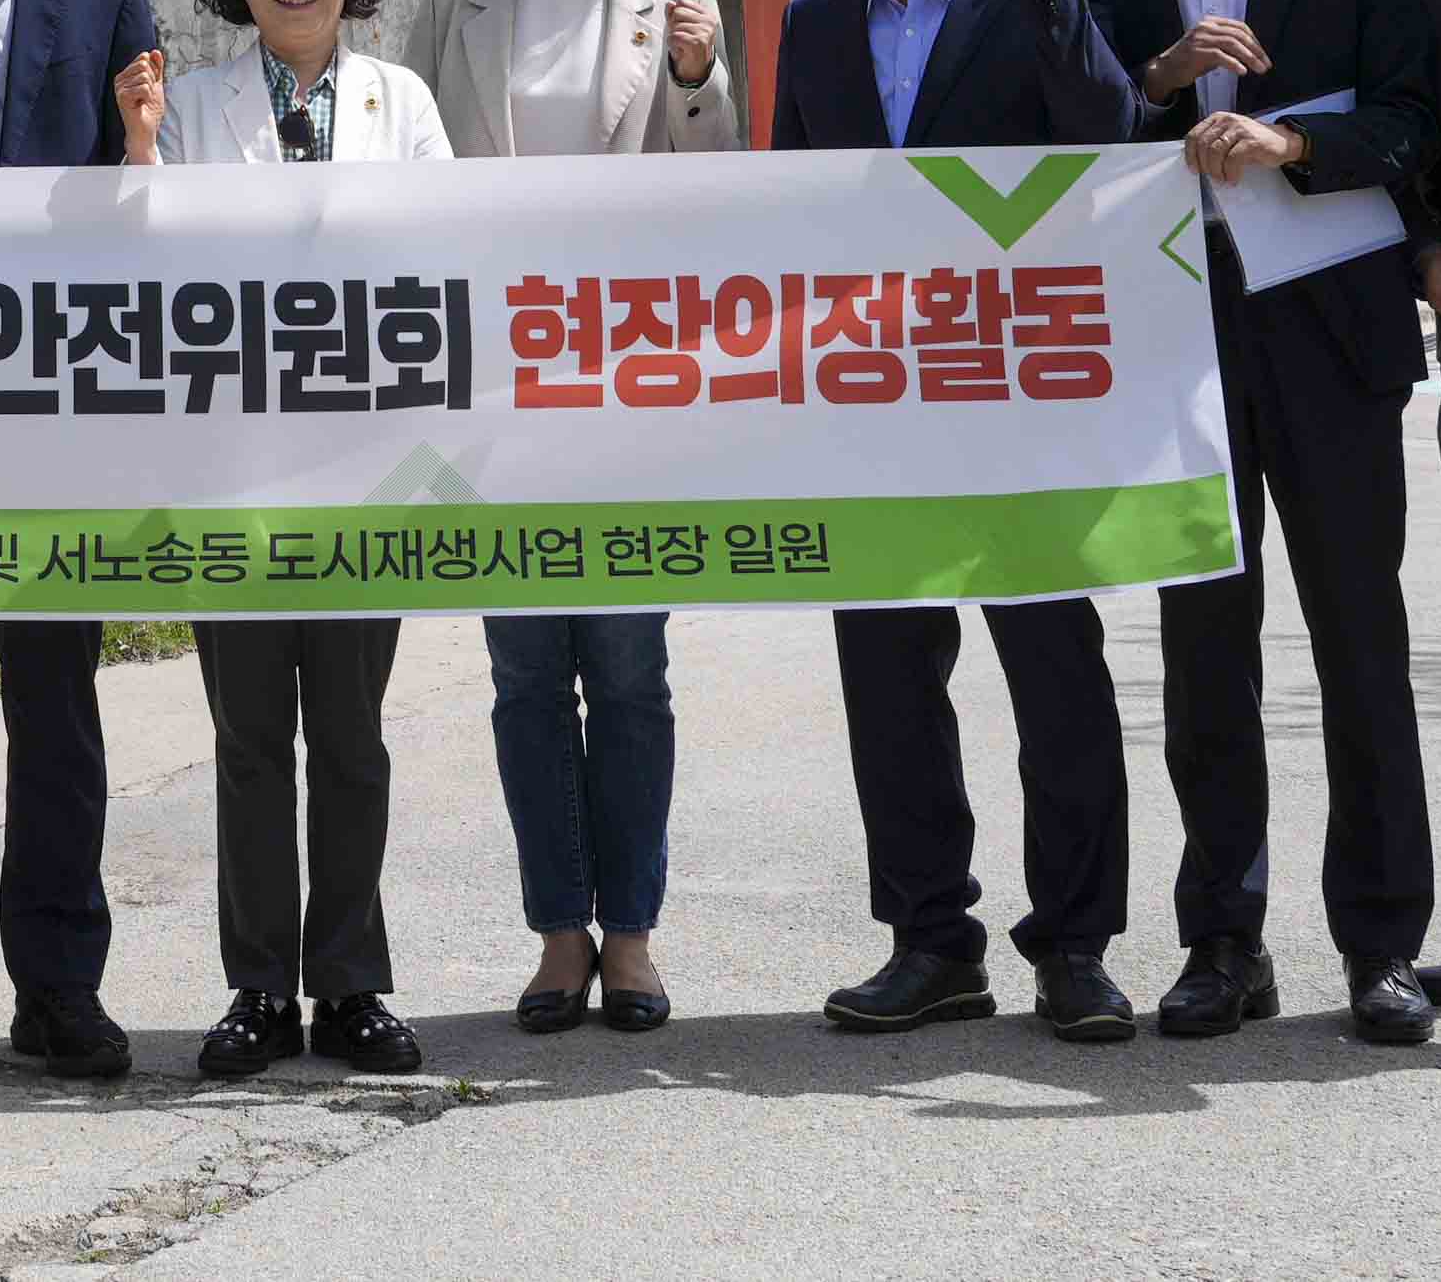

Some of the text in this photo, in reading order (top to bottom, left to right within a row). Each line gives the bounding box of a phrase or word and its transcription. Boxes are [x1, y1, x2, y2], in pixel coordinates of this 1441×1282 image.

[506, 266, 1115, 411] 현장의정활동
[37, 531, 251, 586] 서노송동
[266, 526, 585, 584] 도시재생사업
[602, 523, 710, 579] 현장
[724, 521, 831, 576] 일원
